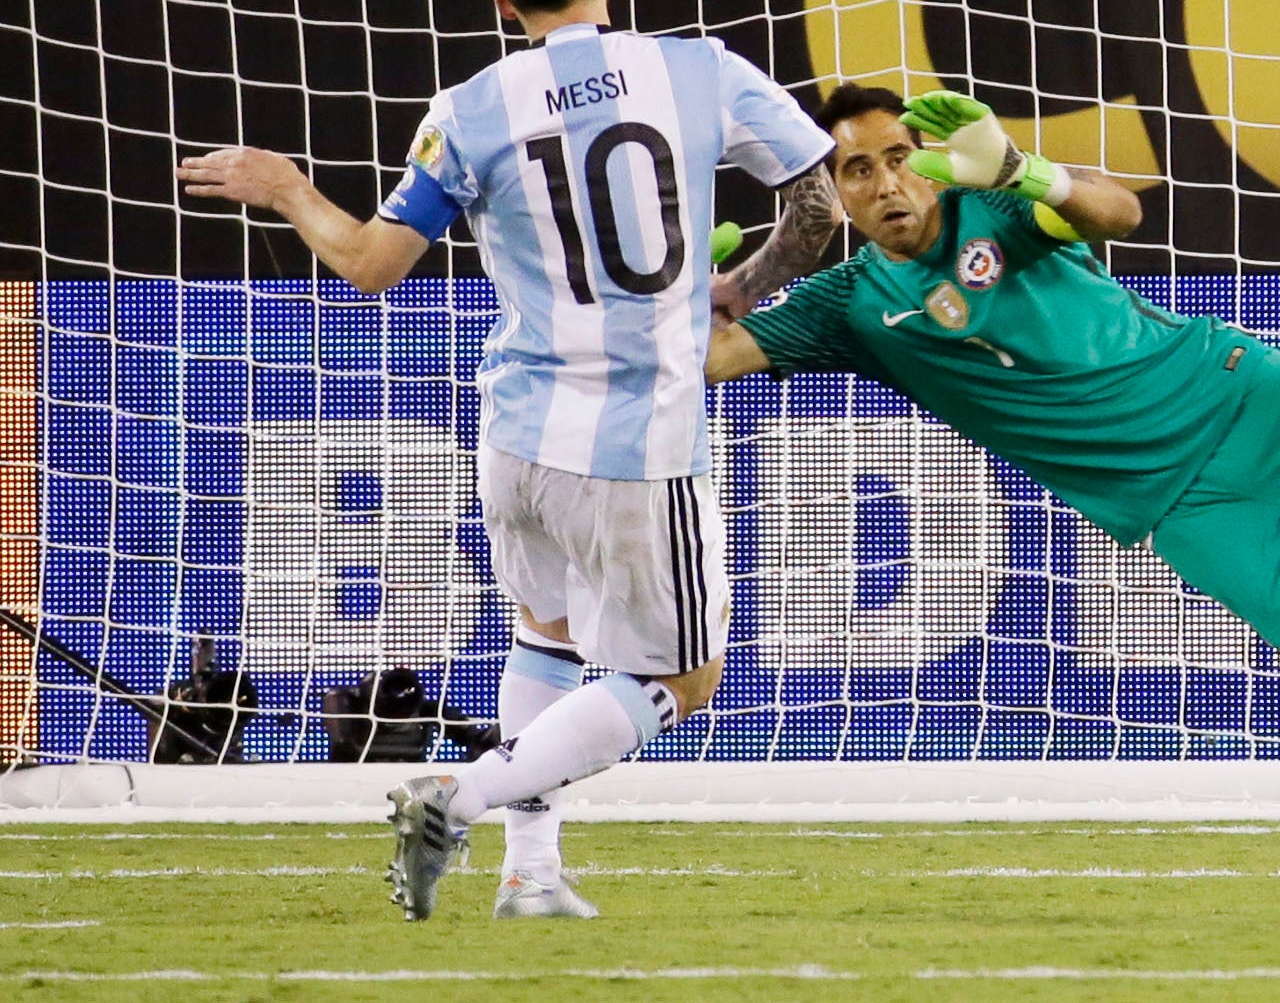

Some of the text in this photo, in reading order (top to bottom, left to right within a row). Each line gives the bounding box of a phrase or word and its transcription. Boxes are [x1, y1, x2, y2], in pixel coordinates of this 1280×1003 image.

[545, 69, 629, 115] MESSI
[526, 122, 686, 305] 10
[246, 417, 1010, 671] BD
